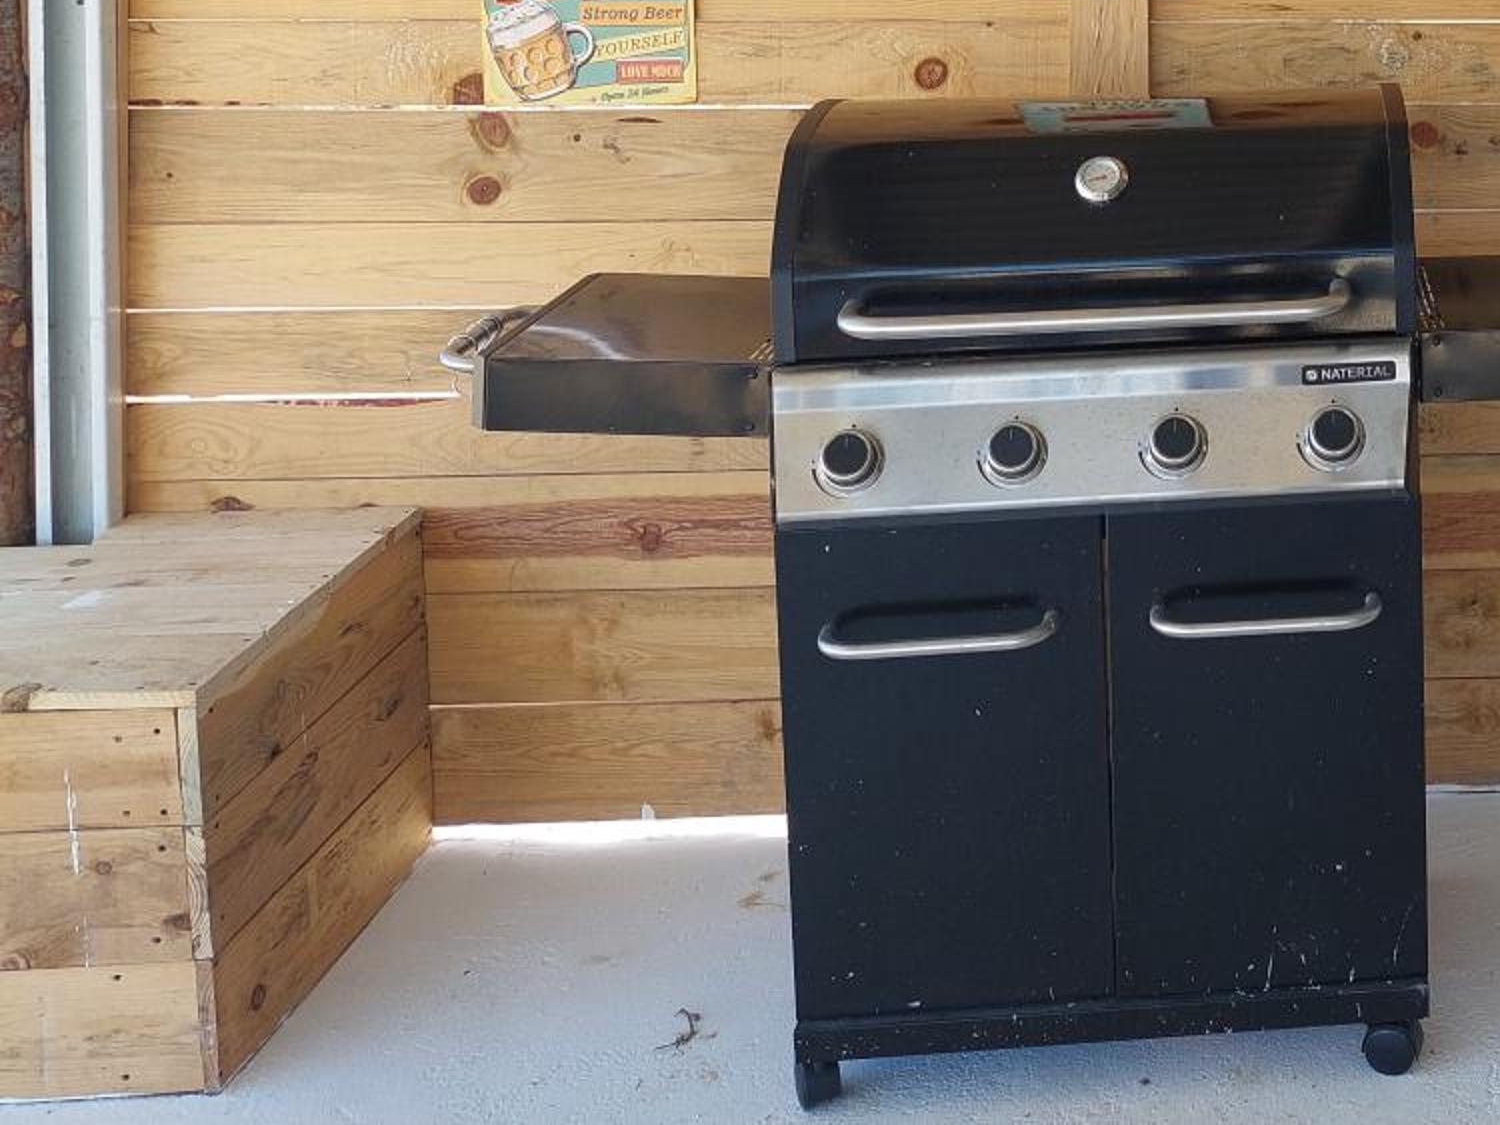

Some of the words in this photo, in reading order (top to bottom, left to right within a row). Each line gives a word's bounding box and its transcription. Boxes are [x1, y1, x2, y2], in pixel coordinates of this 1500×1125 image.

[583, 5, 640, 23] Strong
[643, 5, 683, 21] Beer
[596, 30, 683, 57] YOURSELF
[1321, 366, 1391, 380] NATERIAL
